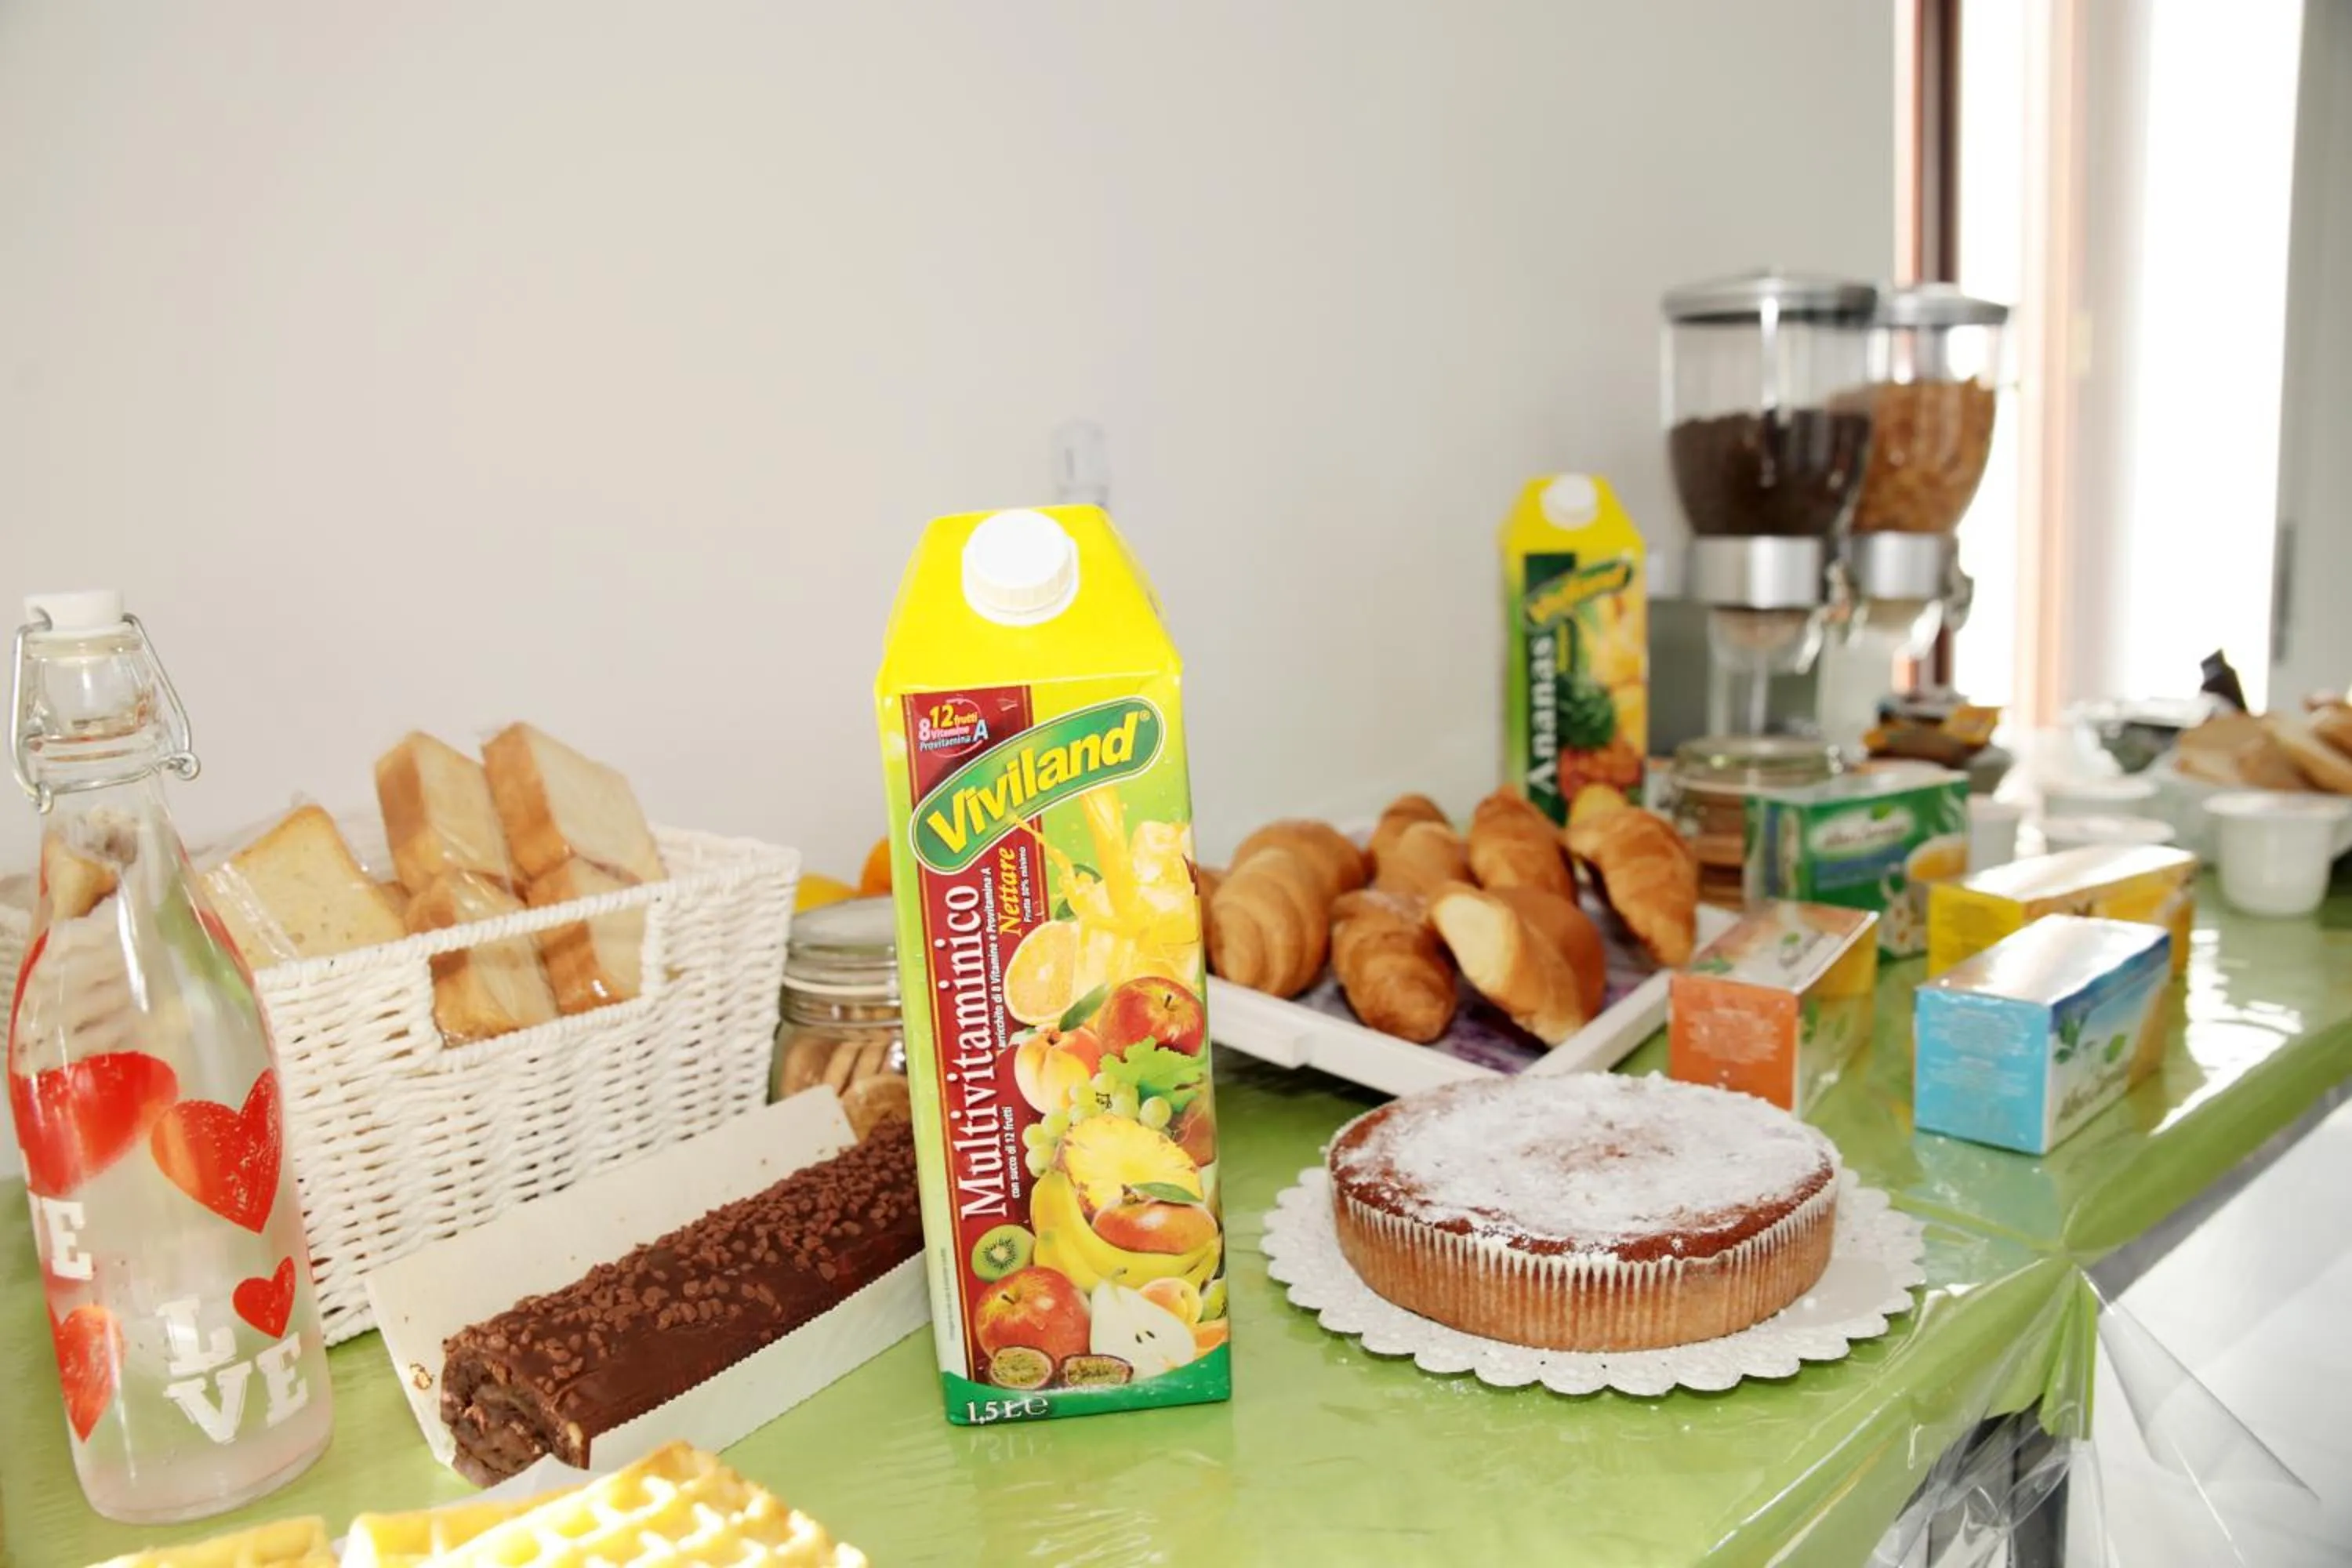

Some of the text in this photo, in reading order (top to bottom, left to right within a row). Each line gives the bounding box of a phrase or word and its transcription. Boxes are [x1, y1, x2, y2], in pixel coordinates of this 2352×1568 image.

[918, 718, 931, 741] 8
[920, 719, 989, 751] Provitamina A
[929, 704, 978, 728] 12 frutti
[1527, 636, 1557, 794] Ananas
[981, 866, 992, 875] A
[982, 877, 996, 933] Provitamina
[997, 847, 1022, 938] Nettare
[988, 942, 1001, 984] Vitamine
[992, 994, 1003, 1004] di
[994, 1004, 1007, 1048] arricchito
[934, 885, 1007, 1221] Multivitaminico
[1002, 1106, 1021, 1199] con succo di 12 frutti
